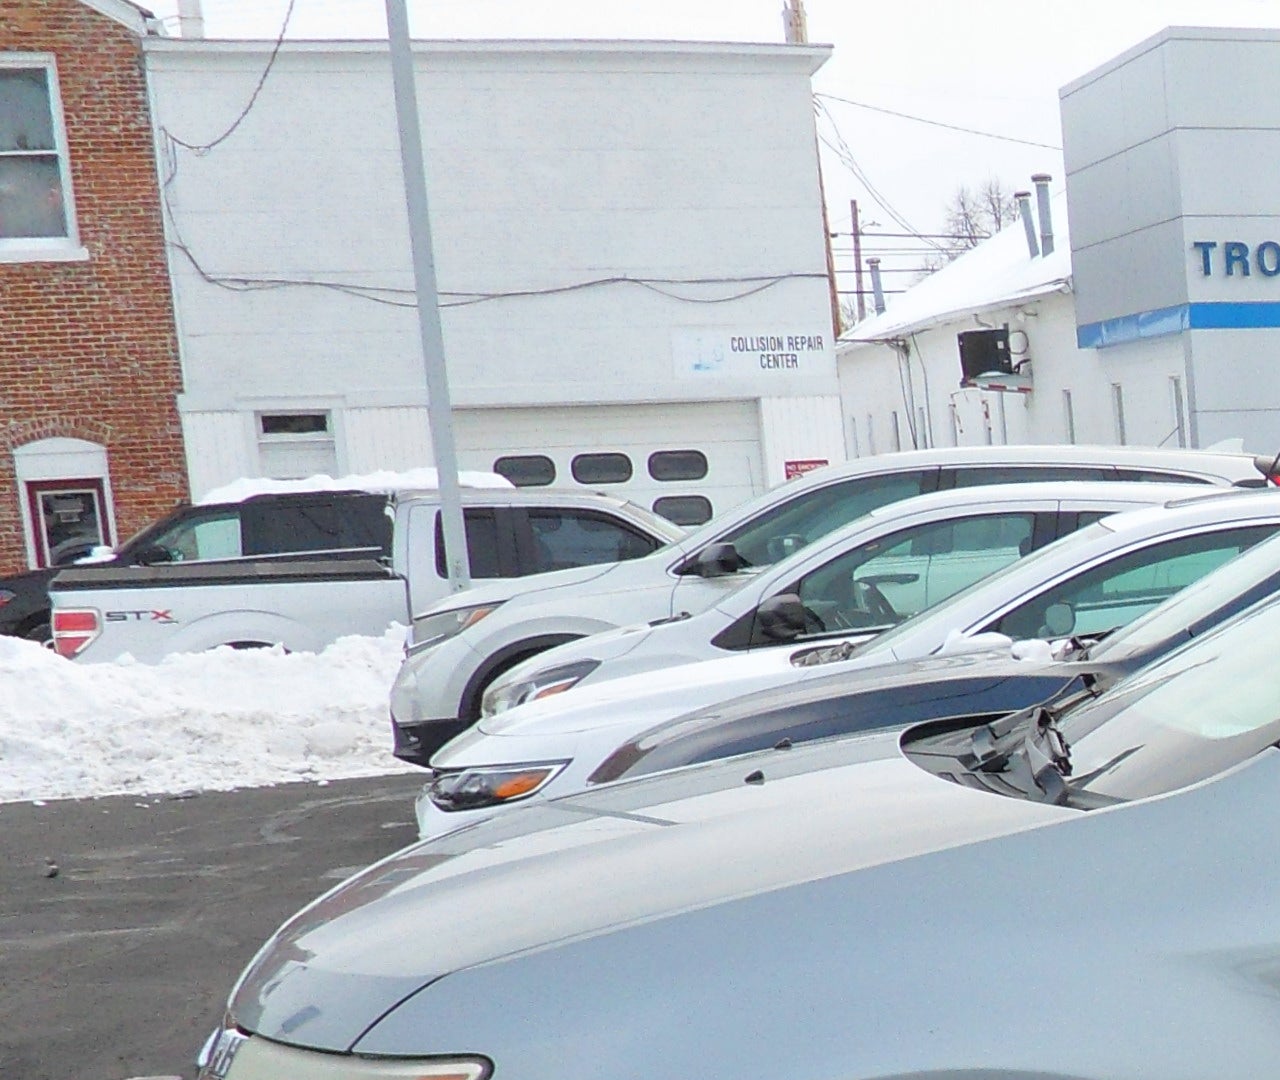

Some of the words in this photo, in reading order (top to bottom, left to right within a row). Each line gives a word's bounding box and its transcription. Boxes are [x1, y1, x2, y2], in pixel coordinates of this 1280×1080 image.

[731, 336, 783, 352] COLLISION
[787, 336, 824, 350] REPAIR
[760, 353, 798, 369] CENTER
[105, 610, 173, 622] STX
